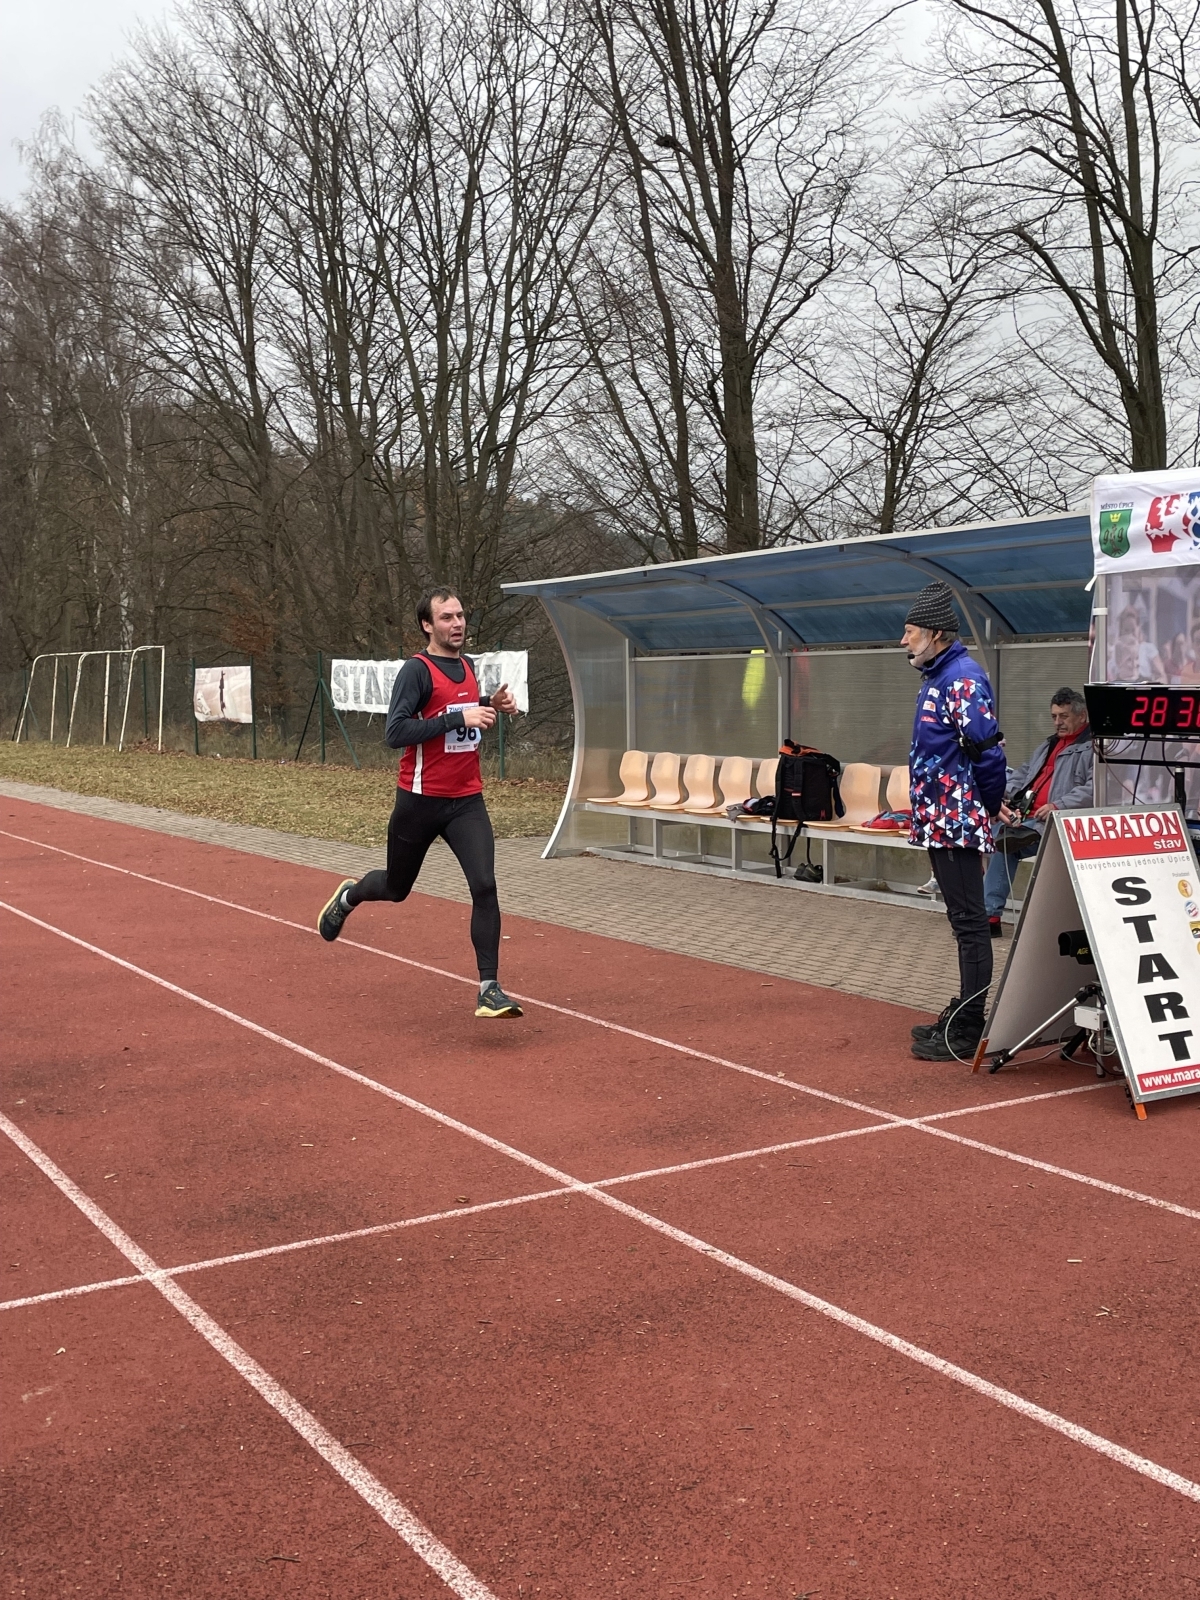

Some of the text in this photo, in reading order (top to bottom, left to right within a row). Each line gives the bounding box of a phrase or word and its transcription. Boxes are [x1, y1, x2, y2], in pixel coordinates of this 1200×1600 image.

[1131, 697, 1200, 727] 28 3
[456, 727, 477, 742] 96
[1063, 811, 1181, 842] MARATON
[1153, 838, 1182, 850] stav
[1134, 856, 1165, 868] jednota
[1111, 876, 1194, 1062] START
